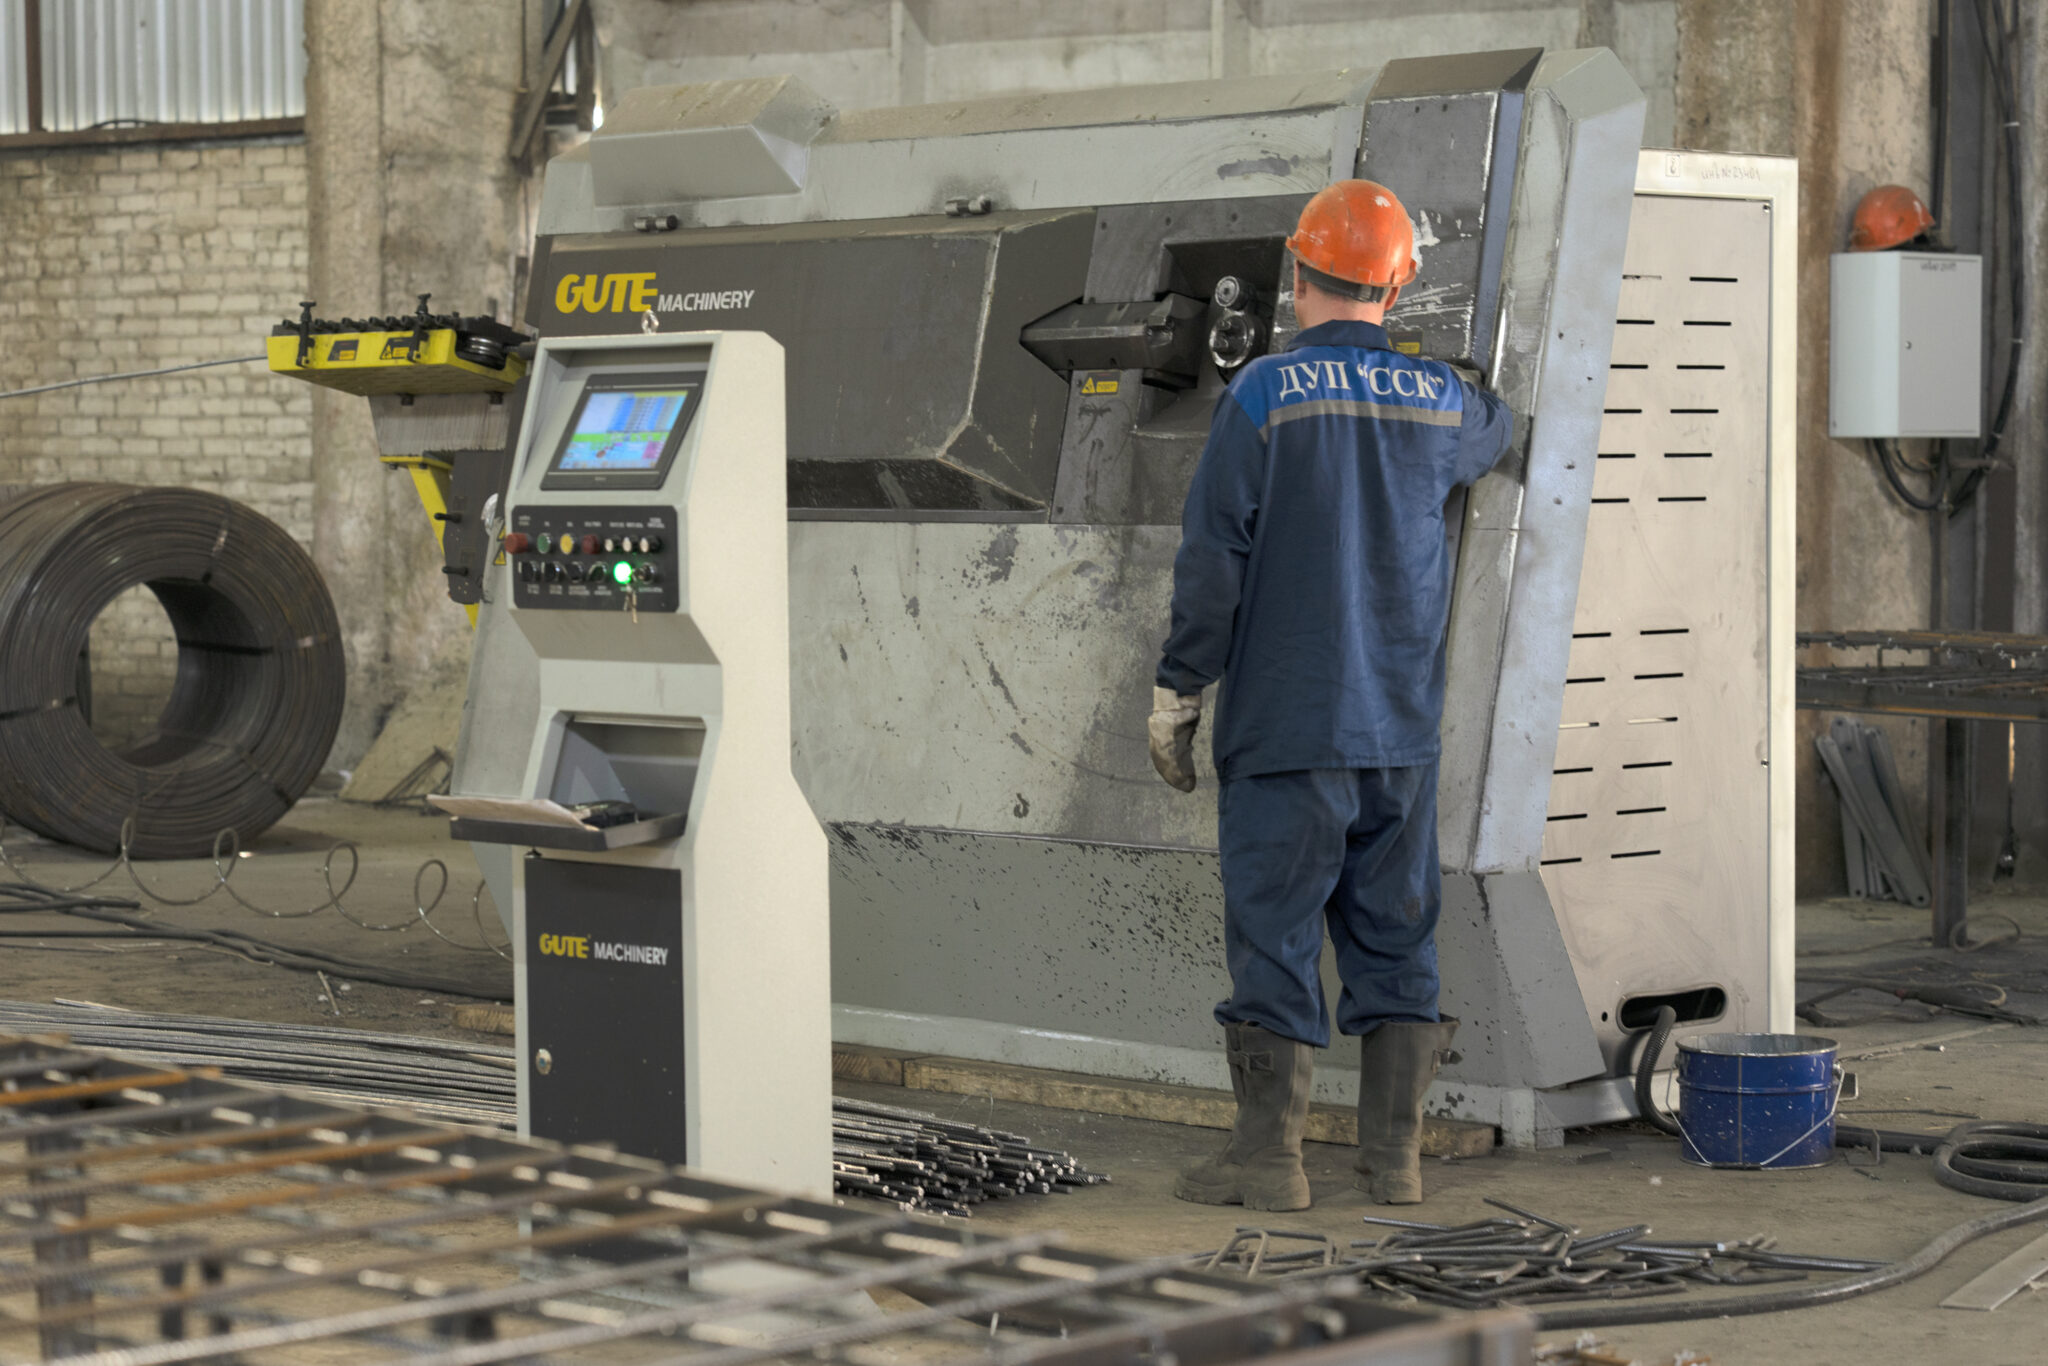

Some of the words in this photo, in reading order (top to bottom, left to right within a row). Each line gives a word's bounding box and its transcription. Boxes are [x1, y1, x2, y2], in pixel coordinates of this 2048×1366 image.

[555, 272, 658, 313] GUTE
[657, 290, 754, 312] MACHINERY
[1277, 361, 1351, 402] ДУП
[539, 933, 589, 959] GUTE
[594, 942, 668, 965] MACHINERY
